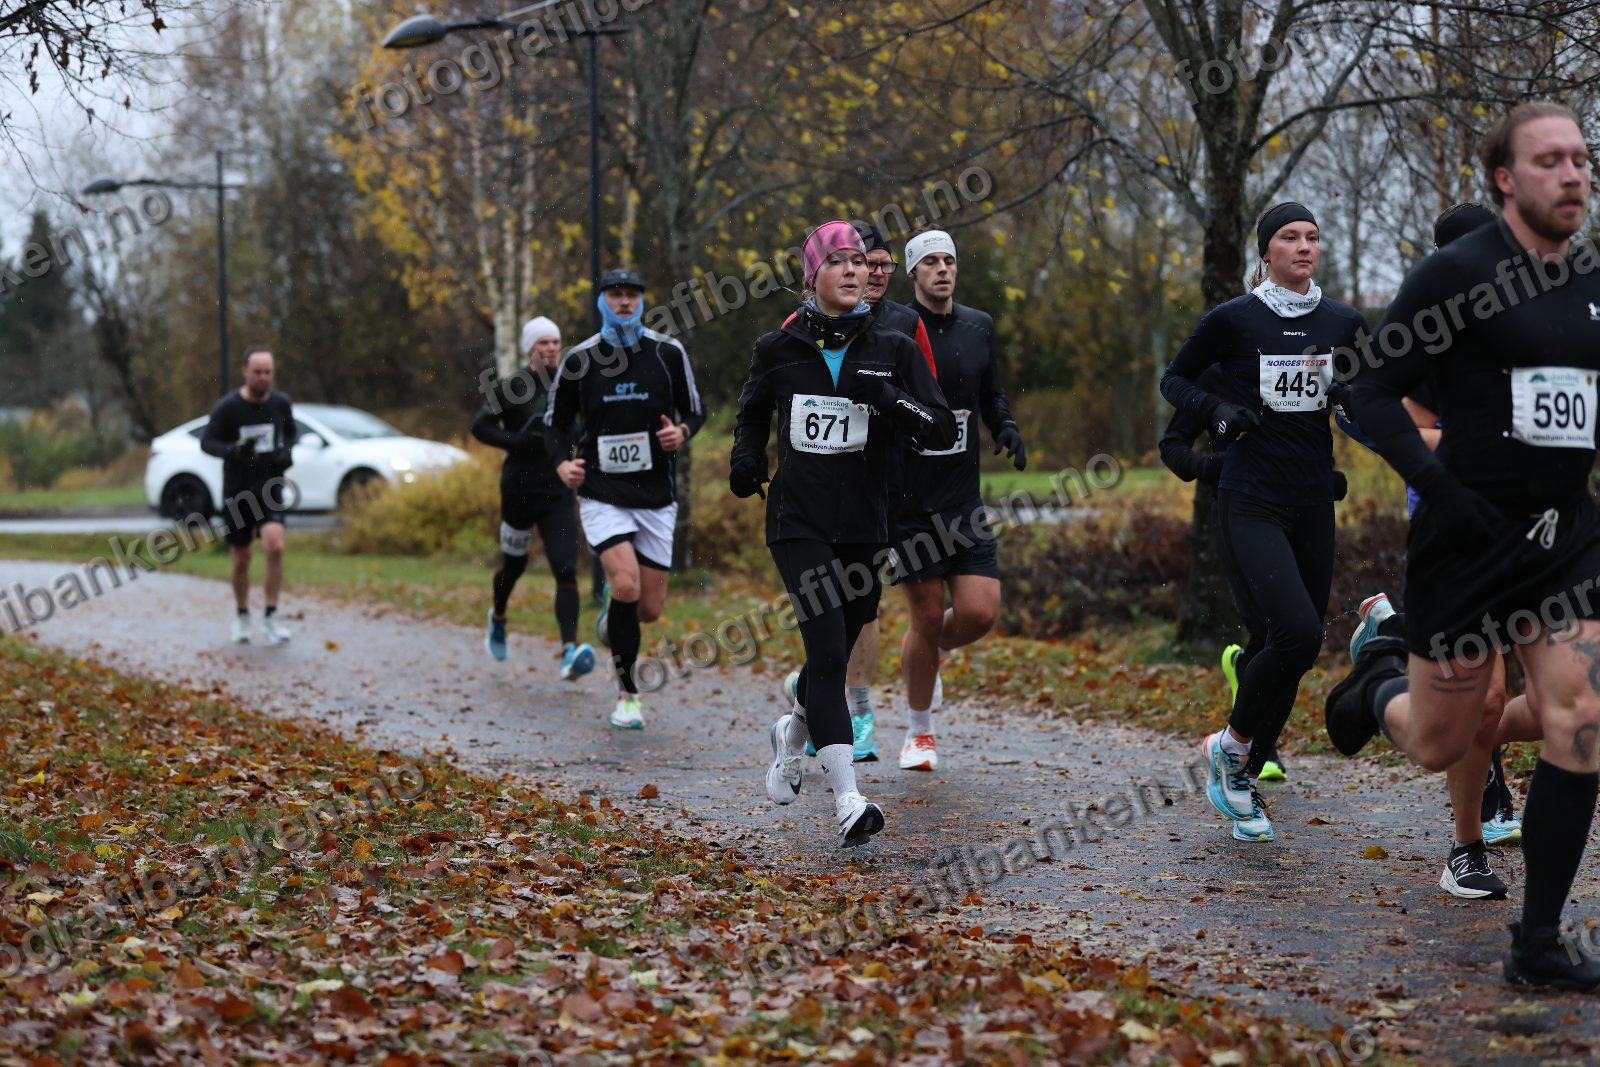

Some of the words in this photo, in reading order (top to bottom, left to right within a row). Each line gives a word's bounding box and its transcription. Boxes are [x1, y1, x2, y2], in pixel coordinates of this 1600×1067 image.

[857, 368, 887, 377] FISCHER
[1267, 359, 1328, 367] NORGESTESTEN
[1275, 371, 1319, 397] 445
[896, 399, 933, 423] FISCHER
[1533, 391, 1586, 430] 590
[806, 413, 849, 442] 671
[609, 444, 640, 463] 402
